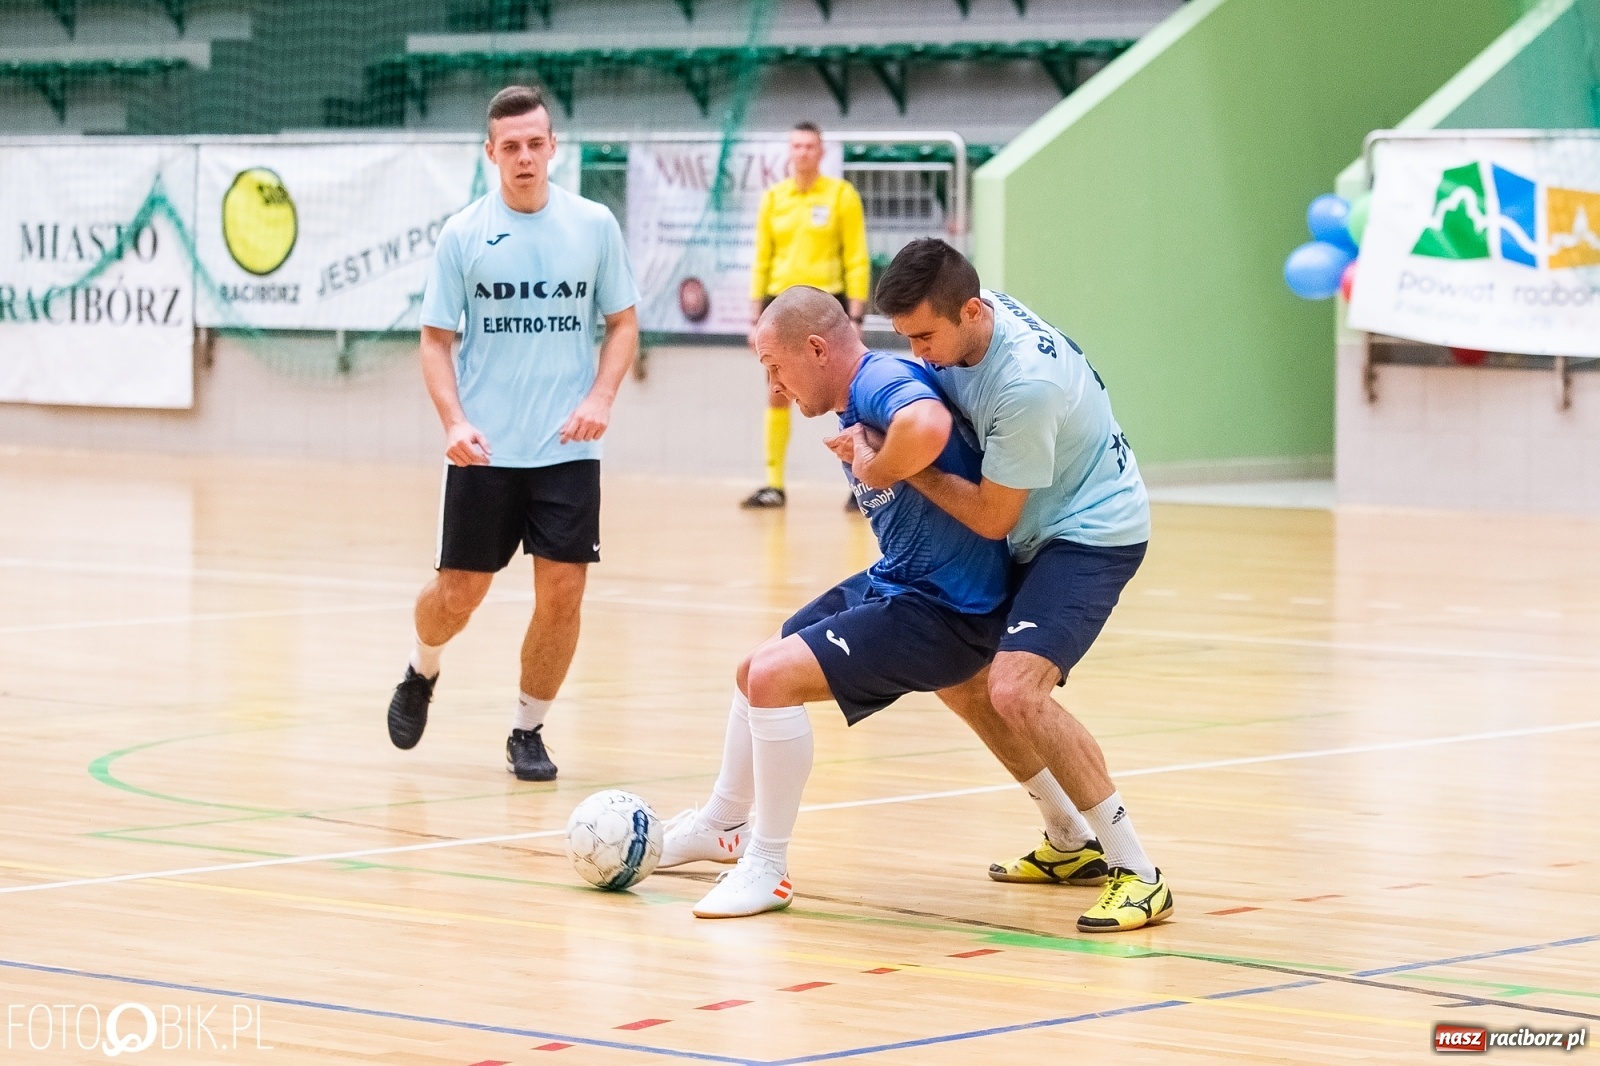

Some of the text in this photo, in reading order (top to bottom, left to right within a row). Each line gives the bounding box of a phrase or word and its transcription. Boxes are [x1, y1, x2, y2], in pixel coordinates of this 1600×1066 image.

[20, 222, 158, 264] MIASTO
[316, 212, 450, 297] JEST W PO
[0, 273, 183, 327] RACIBÓRZ
[474, 280, 588, 300] ADICAR
[483, 315, 582, 334] ELEKTRO-TECH
